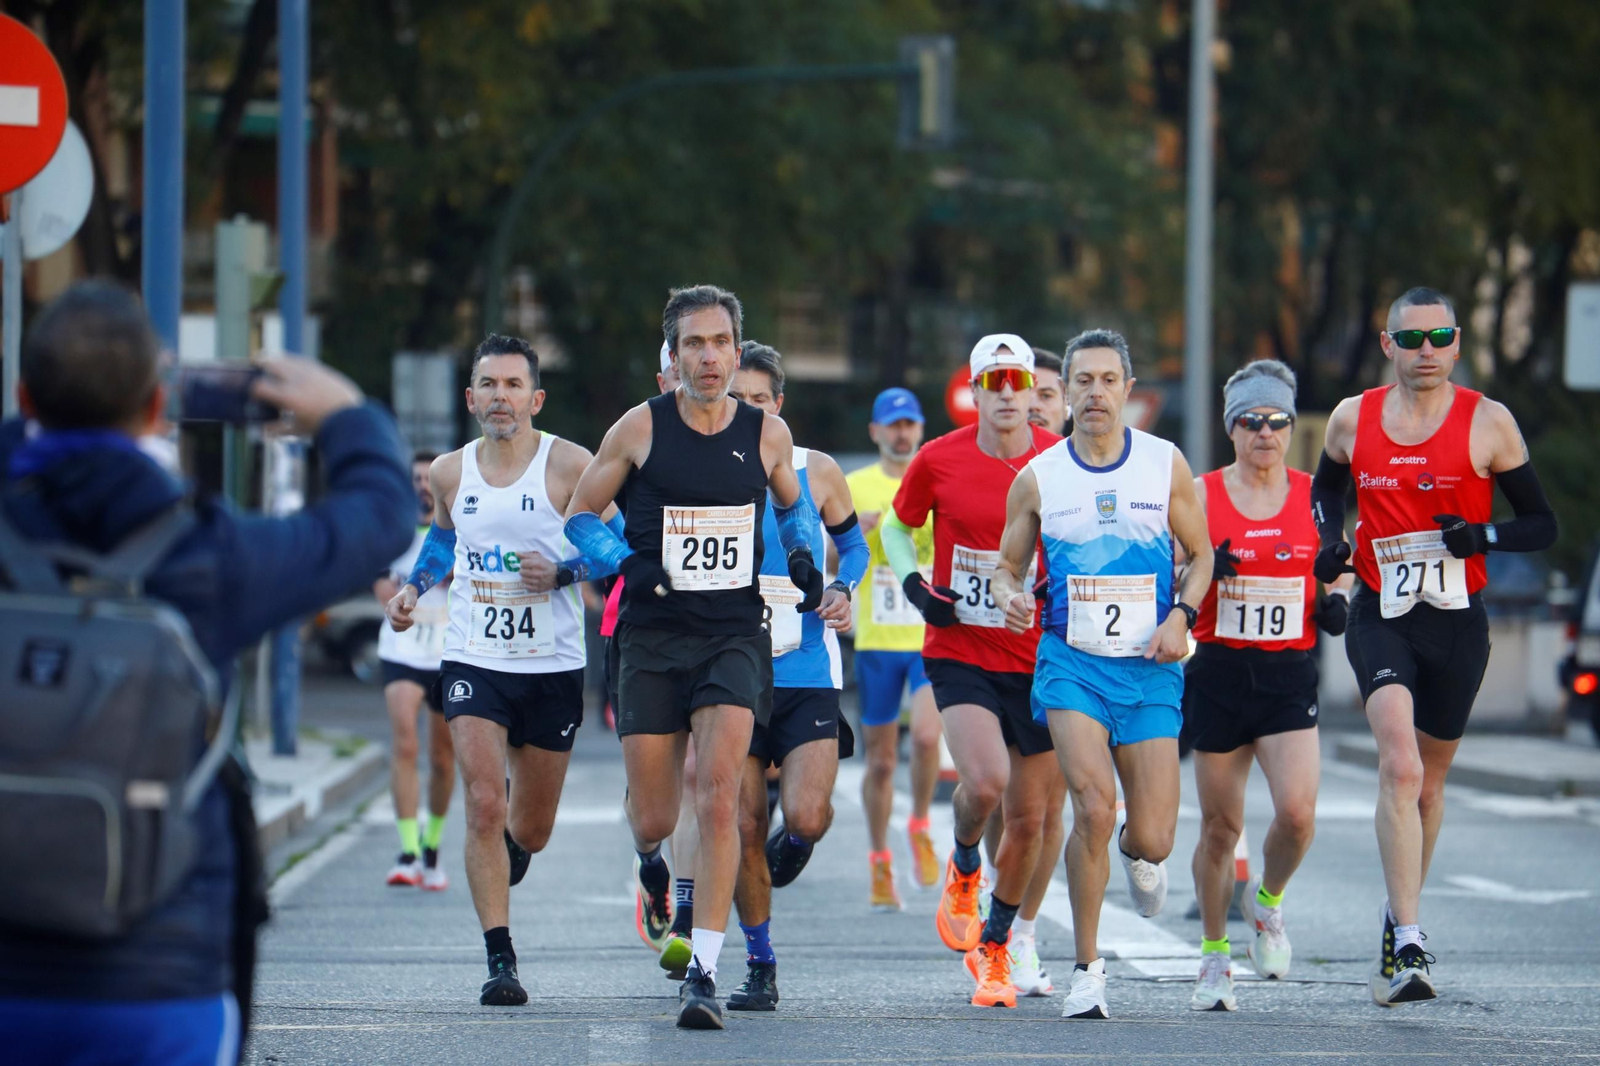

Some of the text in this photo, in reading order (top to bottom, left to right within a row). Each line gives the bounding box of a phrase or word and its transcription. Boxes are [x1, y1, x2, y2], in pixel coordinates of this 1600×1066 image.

[1366, 476, 1398, 487] califas
[667, 510, 695, 535] XLI
[1048, 507, 1082, 520] OTTOBOSLEY
[682, 537, 738, 571] 295
[1230, 548, 1256, 558] lifas
[1072, 578, 1097, 602] XLI
[1396, 560, 1445, 597] 271
[471, 580, 495, 604] XLI
[484, 606, 535, 640] 234
[1105, 604, 1121, 636] 2
[1236, 604, 1286, 635] 119
